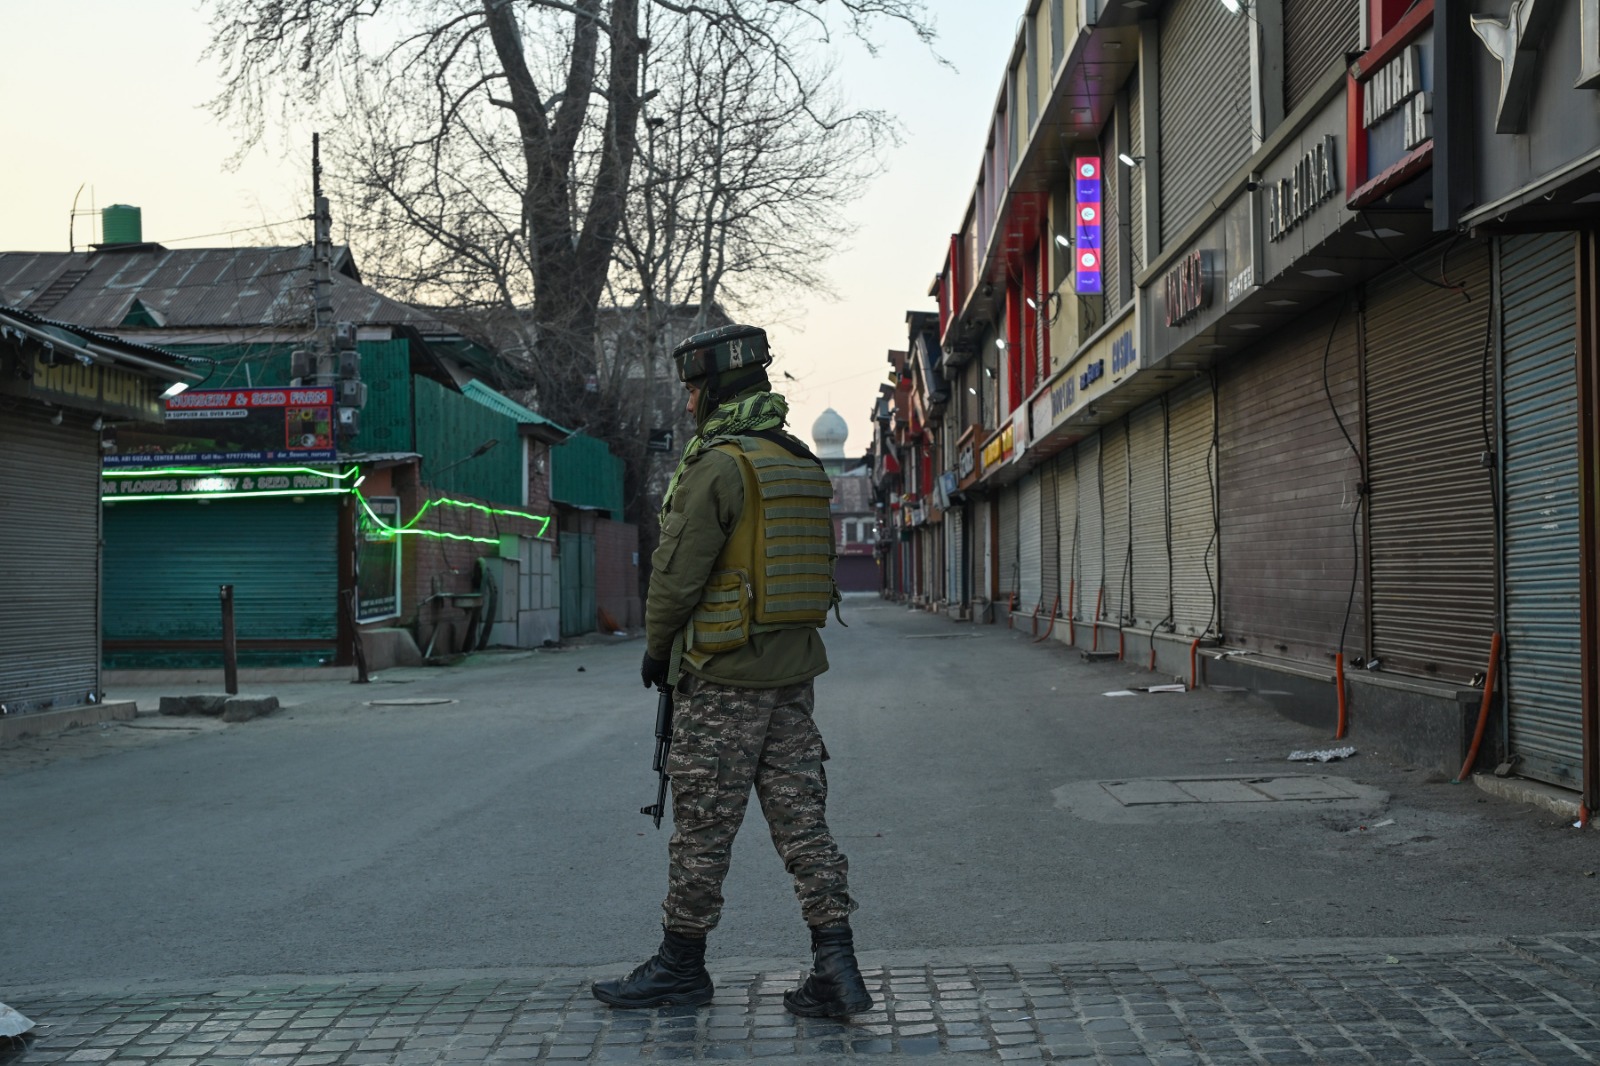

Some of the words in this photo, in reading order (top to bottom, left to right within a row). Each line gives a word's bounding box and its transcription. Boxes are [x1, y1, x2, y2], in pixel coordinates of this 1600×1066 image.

[1362, 44, 1420, 130] AMIRA
[169, 394, 231, 408] NURSERY
[235, 393, 248, 405] &
[251, 392, 286, 405] SEED
[290, 391, 328, 404] FARM
[120, 479, 178, 493] FLOWERS
[181, 478, 240, 492] NURSERY
[242, 477, 254, 490] &
[258, 476, 290, 489] SEED
[293, 475, 328, 488] FARM
